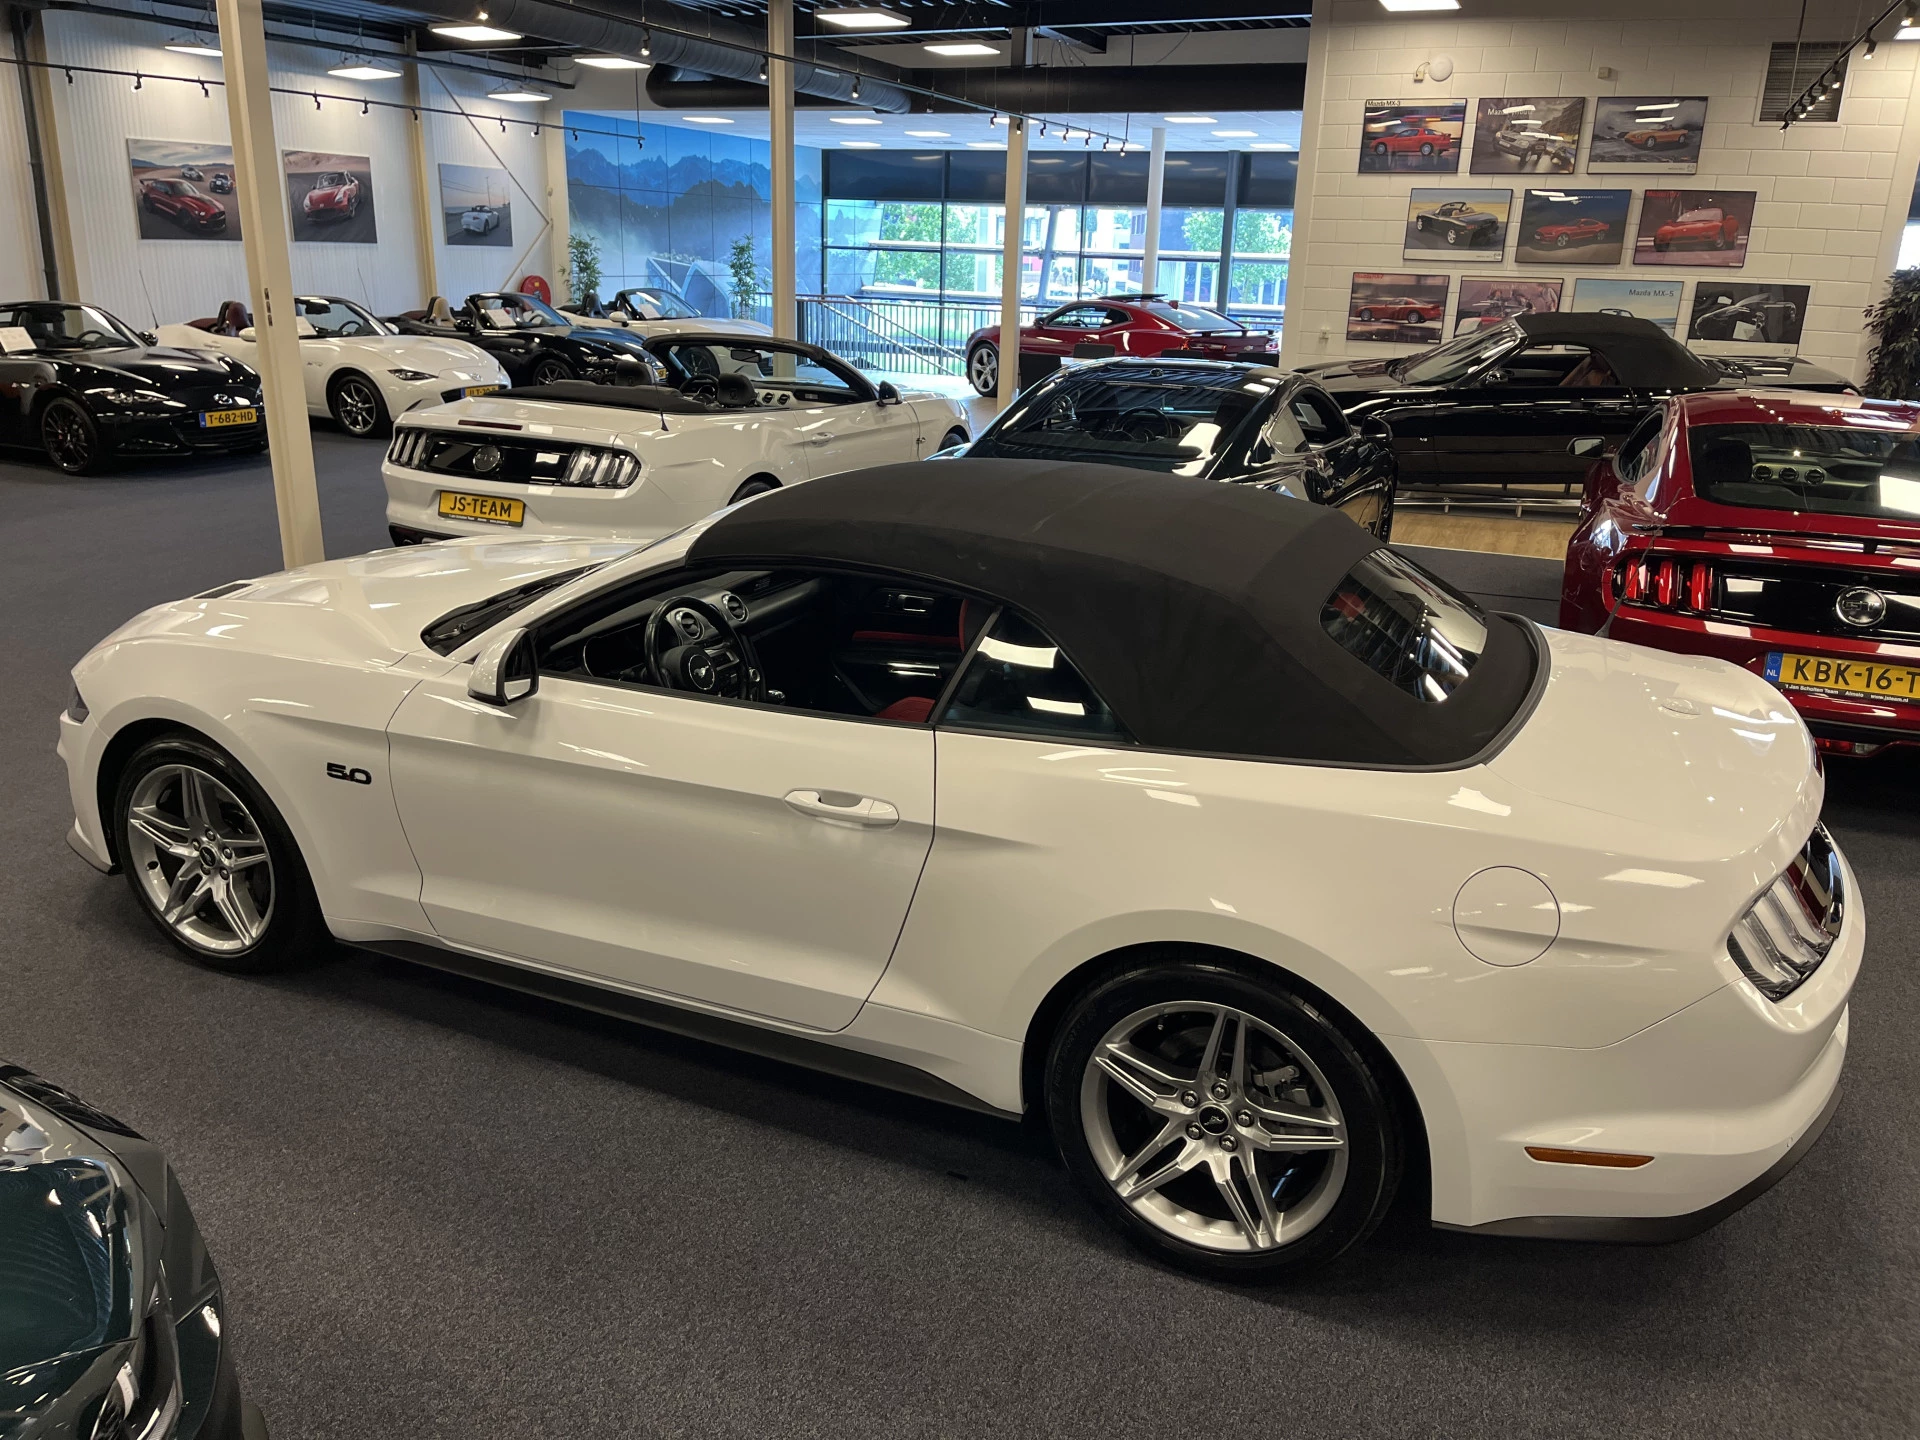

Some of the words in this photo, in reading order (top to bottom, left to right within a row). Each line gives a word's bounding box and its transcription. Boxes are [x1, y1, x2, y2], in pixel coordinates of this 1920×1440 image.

[208, 411, 254, 424] T-682-HD
[450, 496, 512, 518] JS-TEAM
[1766, 669, 1778, 677] NL
[1793, 658, 1920, 693] KBK-16-T
